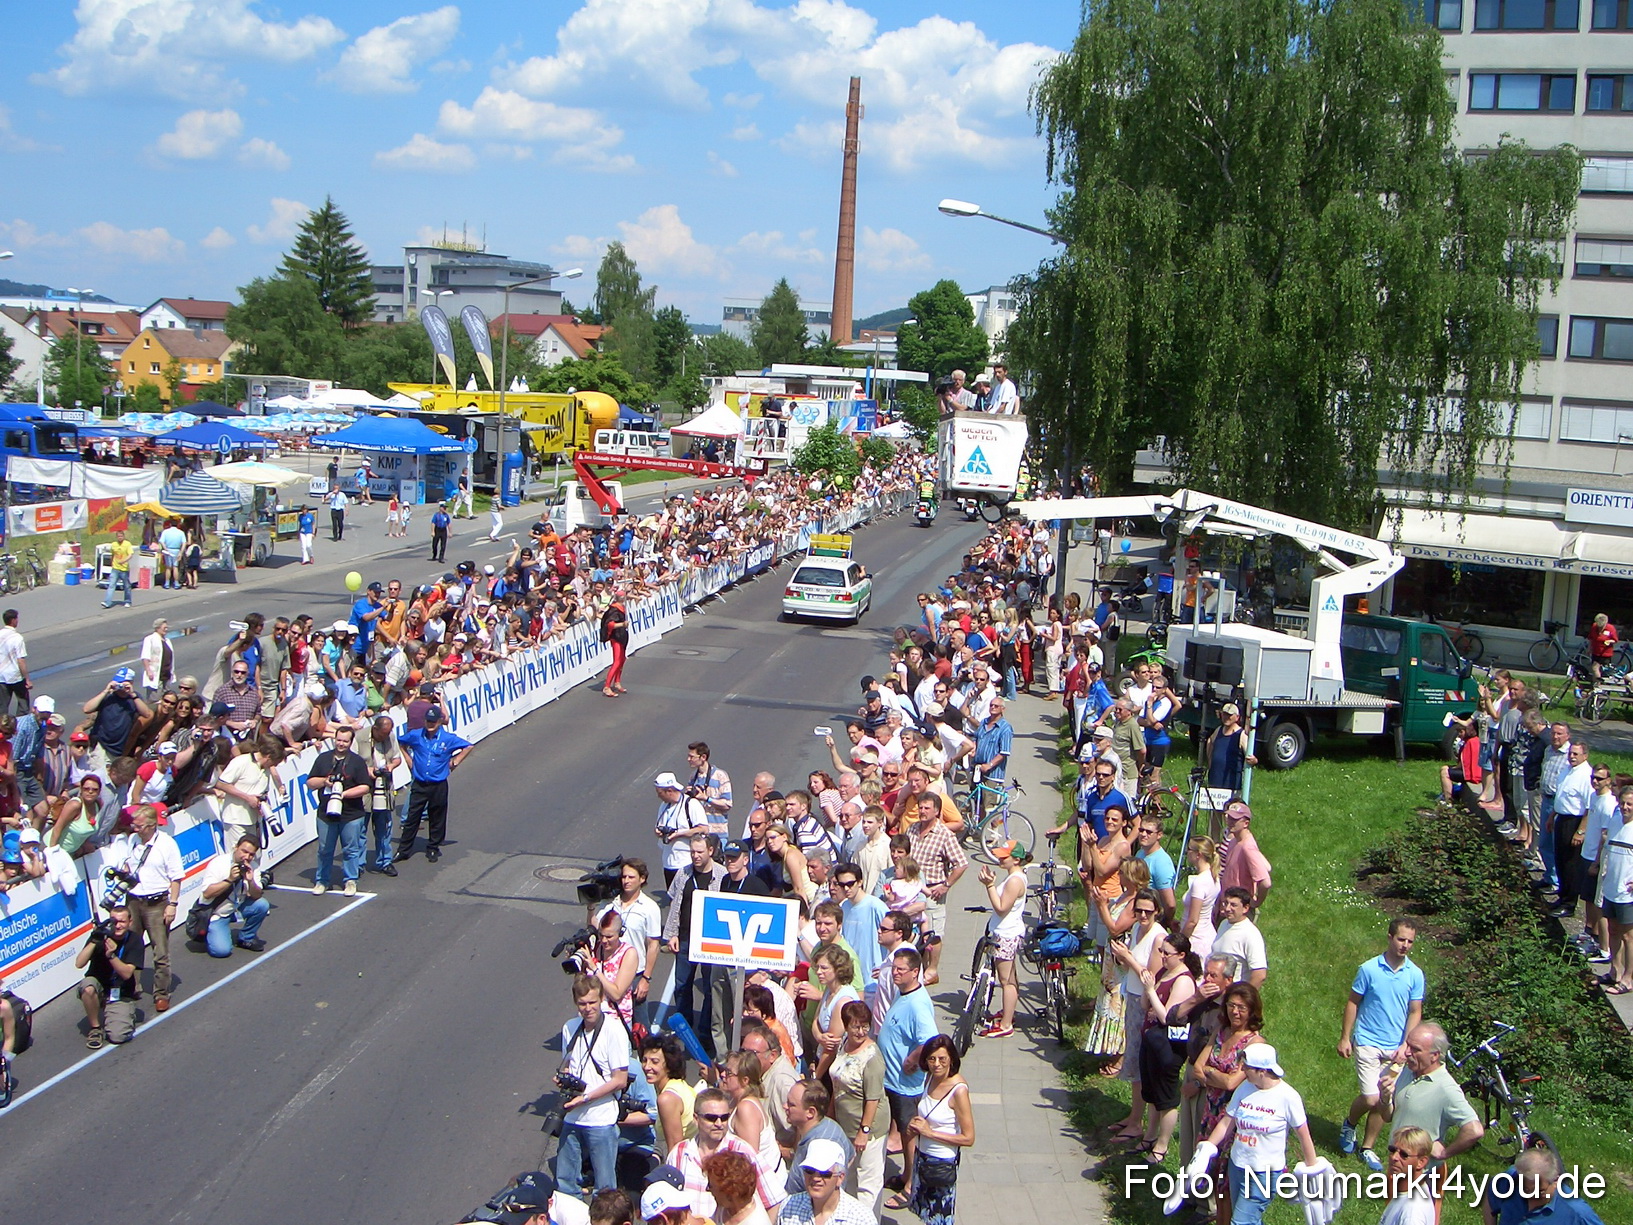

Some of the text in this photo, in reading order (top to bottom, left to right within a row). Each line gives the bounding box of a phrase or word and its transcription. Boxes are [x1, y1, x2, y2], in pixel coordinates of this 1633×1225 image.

[544, 408, 566, 444] ADAC
[378, 455, 402, 470] KMP
[372, 483, 387, 491] KMP
[1223, 504, 1287, 530] JGS-Mietservice
[1344, 538, 1354, 547] 63
[1356, 540, 1365, 550] 52
[1412, 546, 1440, 557] Das
[1447, 550, 1545, 568] Fachgeschäft
[507, 664, 526, 702] R+V
[527, 656, 547, 691] R+V
[460, 686, 481, 726] R+V
[483, 675, 505, 714] R+V
[41, 947, 76, 973] Gesundheit
[692, 952, 792, 968] Volksbanken Raiffeisenbanken
